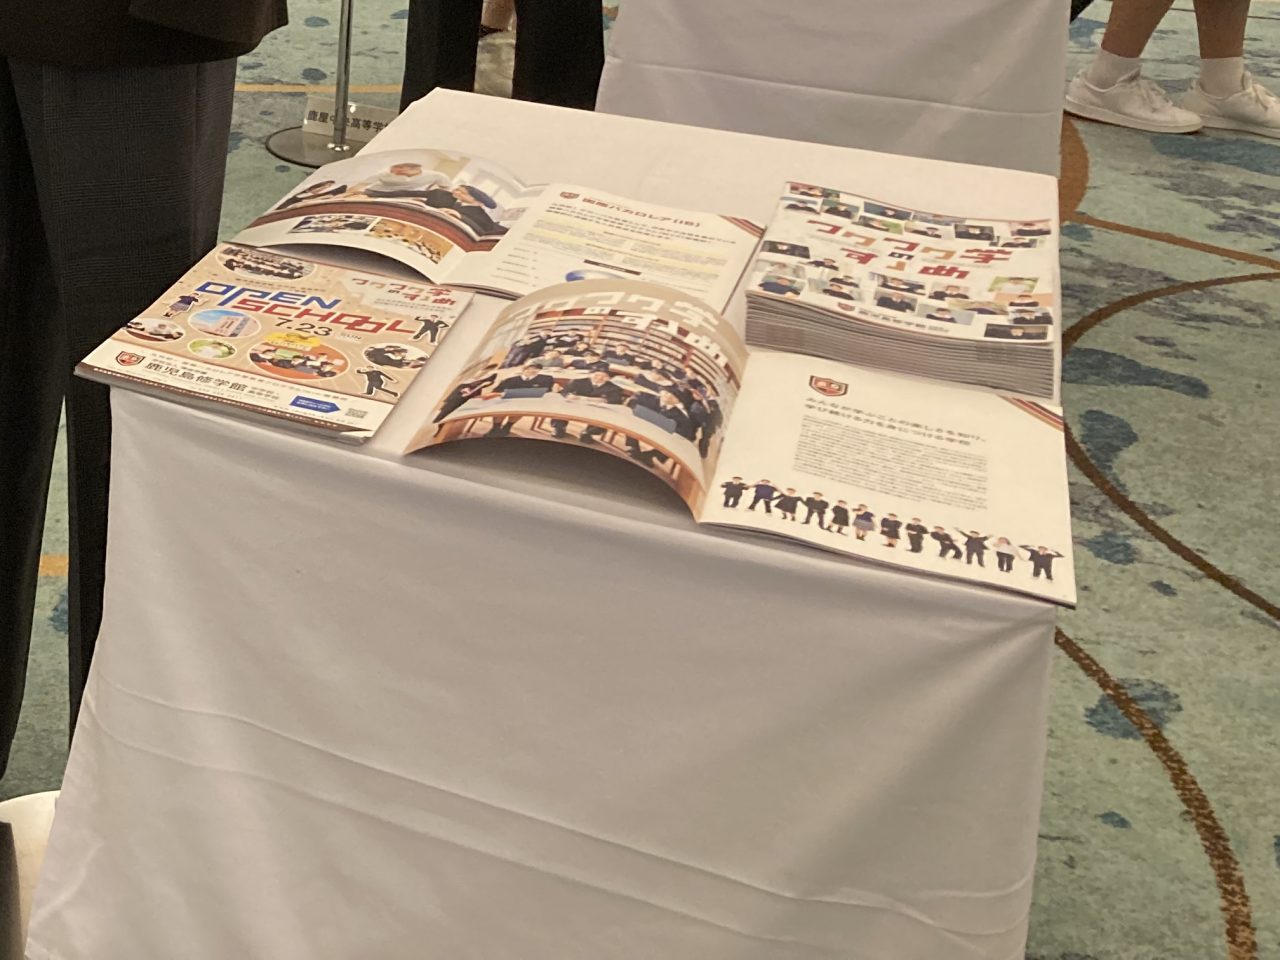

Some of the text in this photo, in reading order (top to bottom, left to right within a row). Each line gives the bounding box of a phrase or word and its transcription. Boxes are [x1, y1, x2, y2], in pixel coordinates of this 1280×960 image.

[307, 109, 389, 133] 鹿屋高等学
[195, 281, 342, 309] OPEN
[232, 298, 416, 334] SCHOOL
[274, 317, 333, 337] 7.23
[144, 361, 249, 393] 鹿児島修学館
